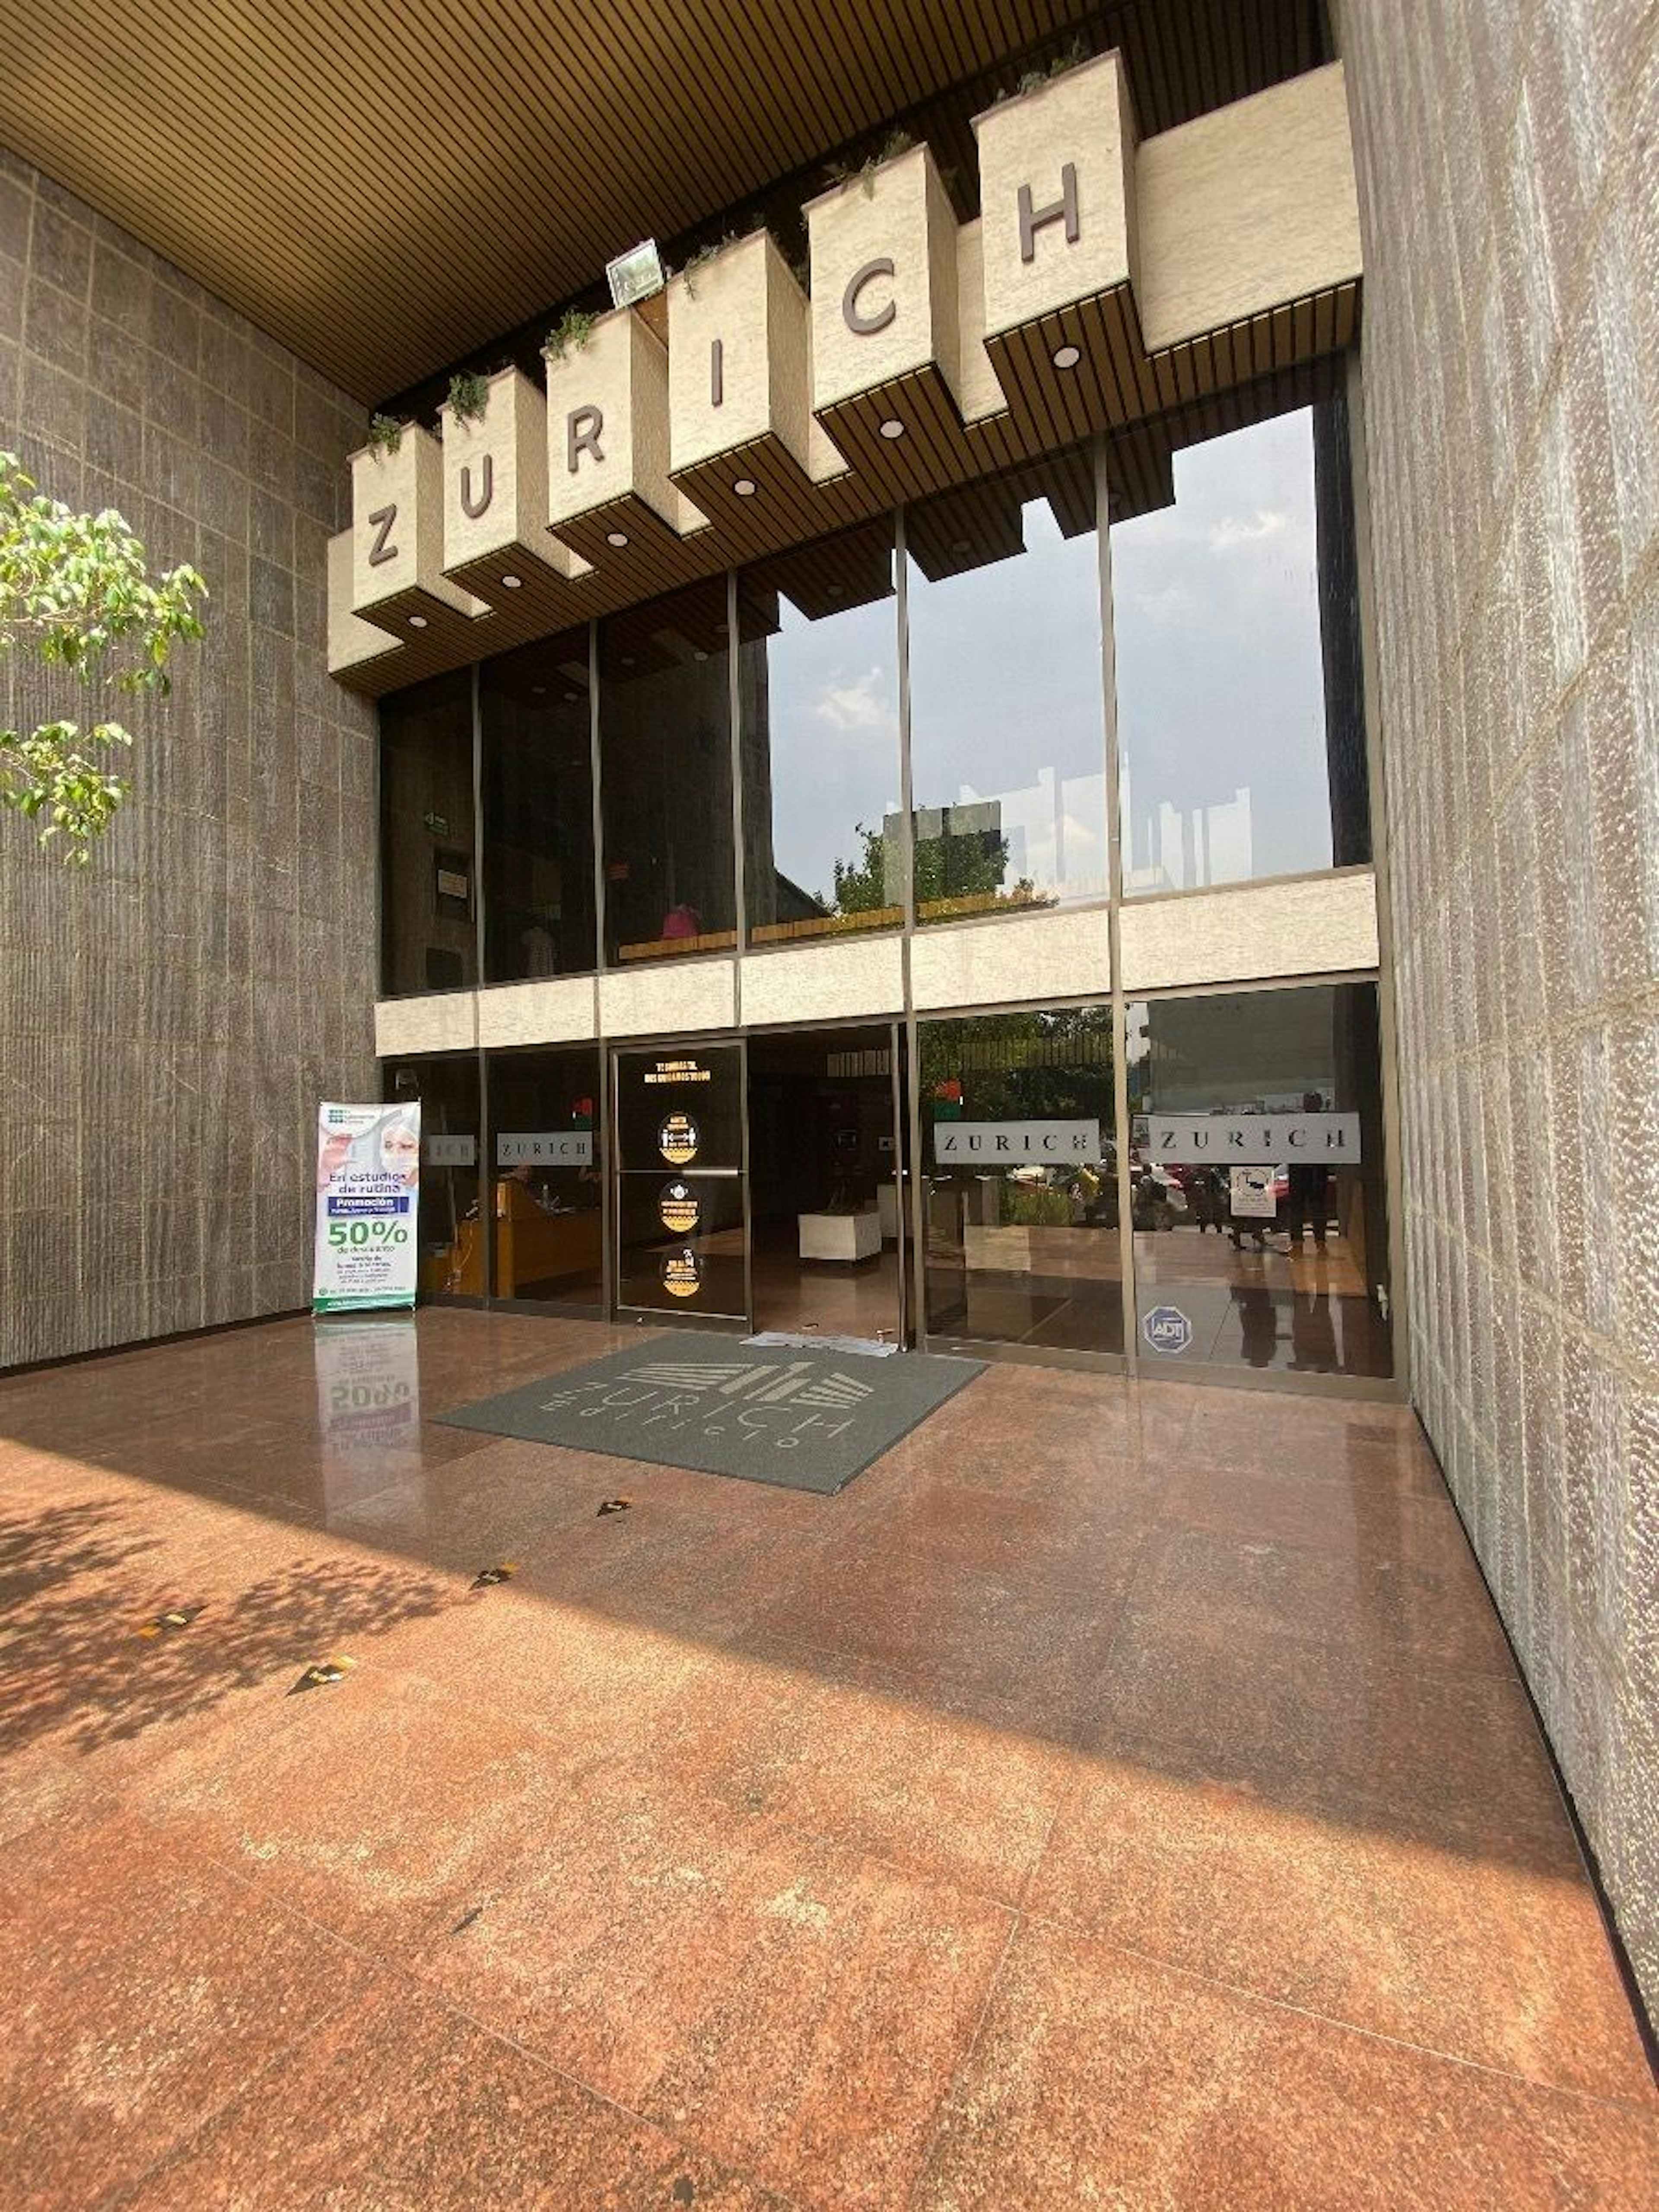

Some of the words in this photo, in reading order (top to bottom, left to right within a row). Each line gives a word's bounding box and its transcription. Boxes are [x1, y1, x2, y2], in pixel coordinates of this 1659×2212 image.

[369, 162, 1080, 567] ZURICH
[944, 1135, 1087, 1151] ZURICH
[1161, 1129, 1345, 1149] ZURICH
[502, 1142, 585, 1156] ZURICH
[330, 1173, 345, 1182] En
[360, 1184, 400, 1193] rutina
[336, 1197, 394, 1207] Promoción
[328, 1220, 408, 1246] 50%
[1154, 1322, 1182, 1336] ADT
[553, 1382, 855, 1438] ZURICH
